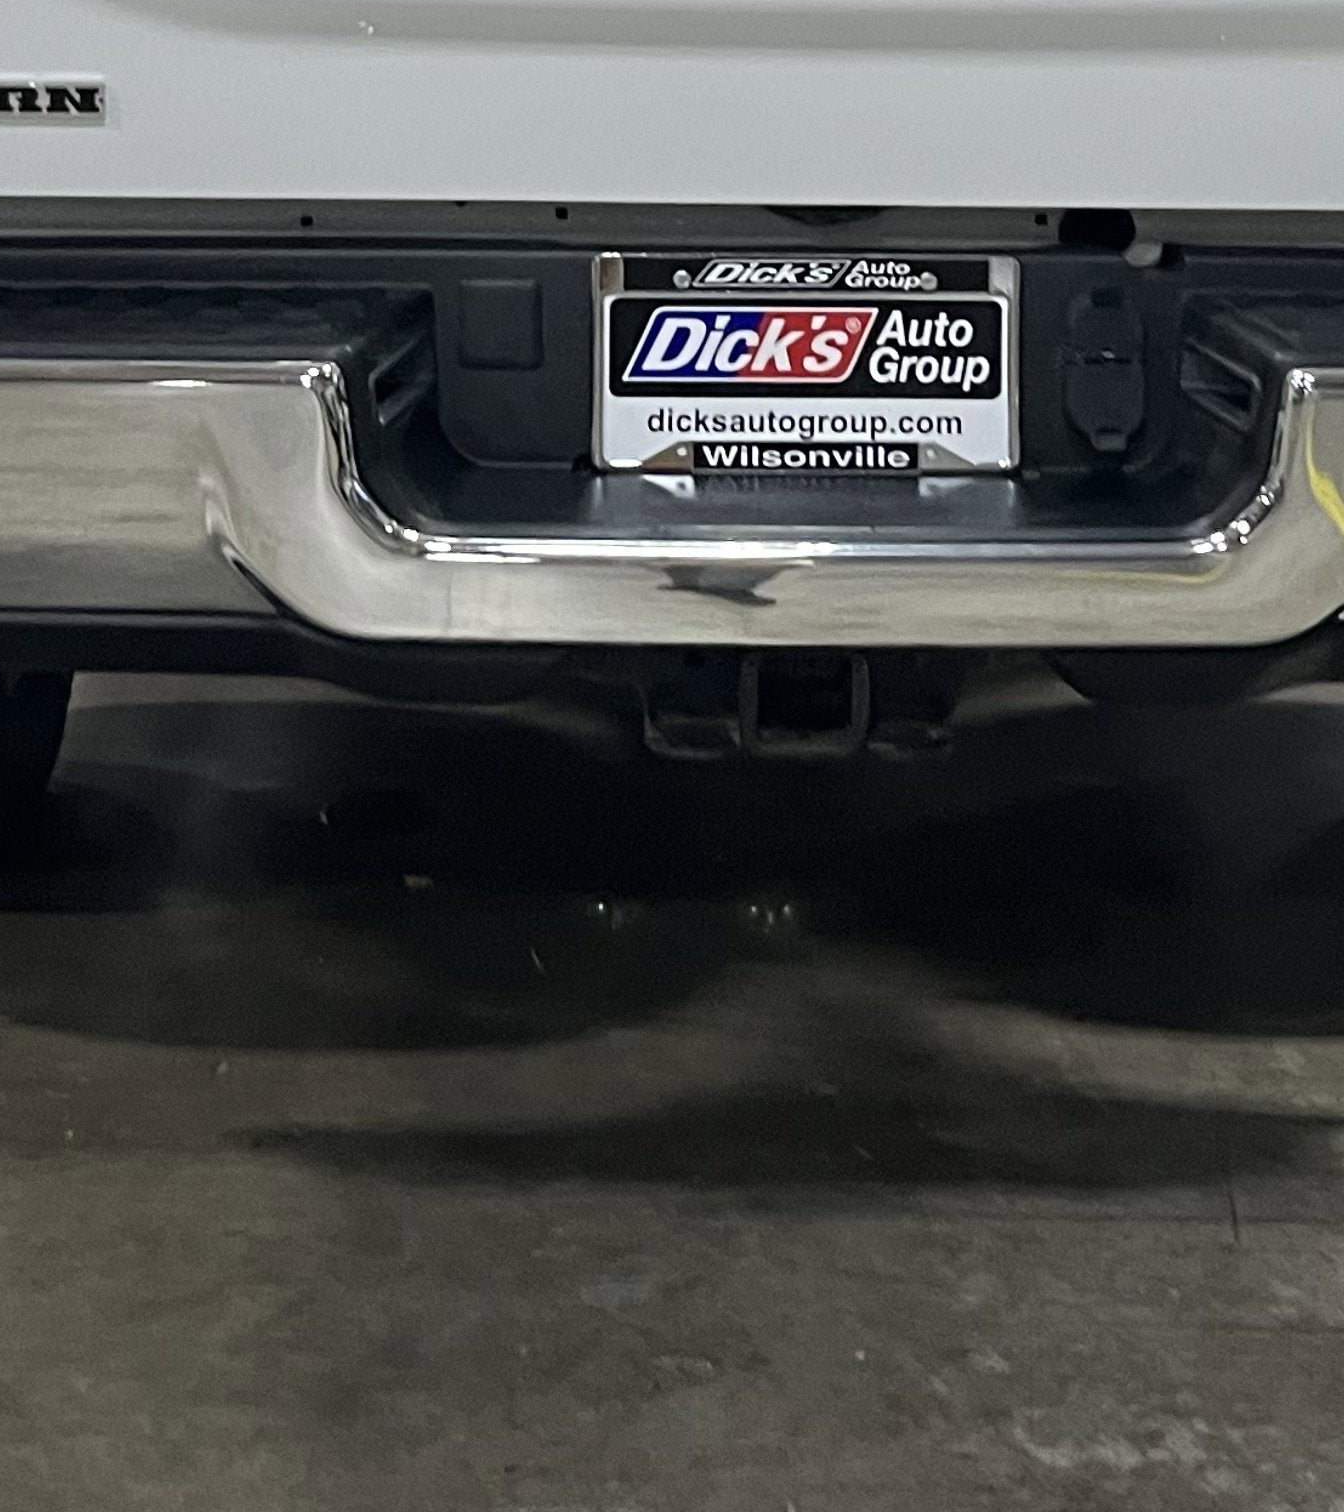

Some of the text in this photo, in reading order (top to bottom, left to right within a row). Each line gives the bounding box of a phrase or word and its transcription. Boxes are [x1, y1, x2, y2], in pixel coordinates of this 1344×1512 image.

[704, 261, 834, 284] Dick's
[845, 273, 921, 290] Group
[852, 260, 911, 275] Auto
[876, 309, 974, 347] Auto
[641, 313, 849, 373] Dick's
[868, 346, 991, 392] Group
[646, 407, 963, 442] dicksautogroup.com
[700, 444, 911, 468] Wilsonville
